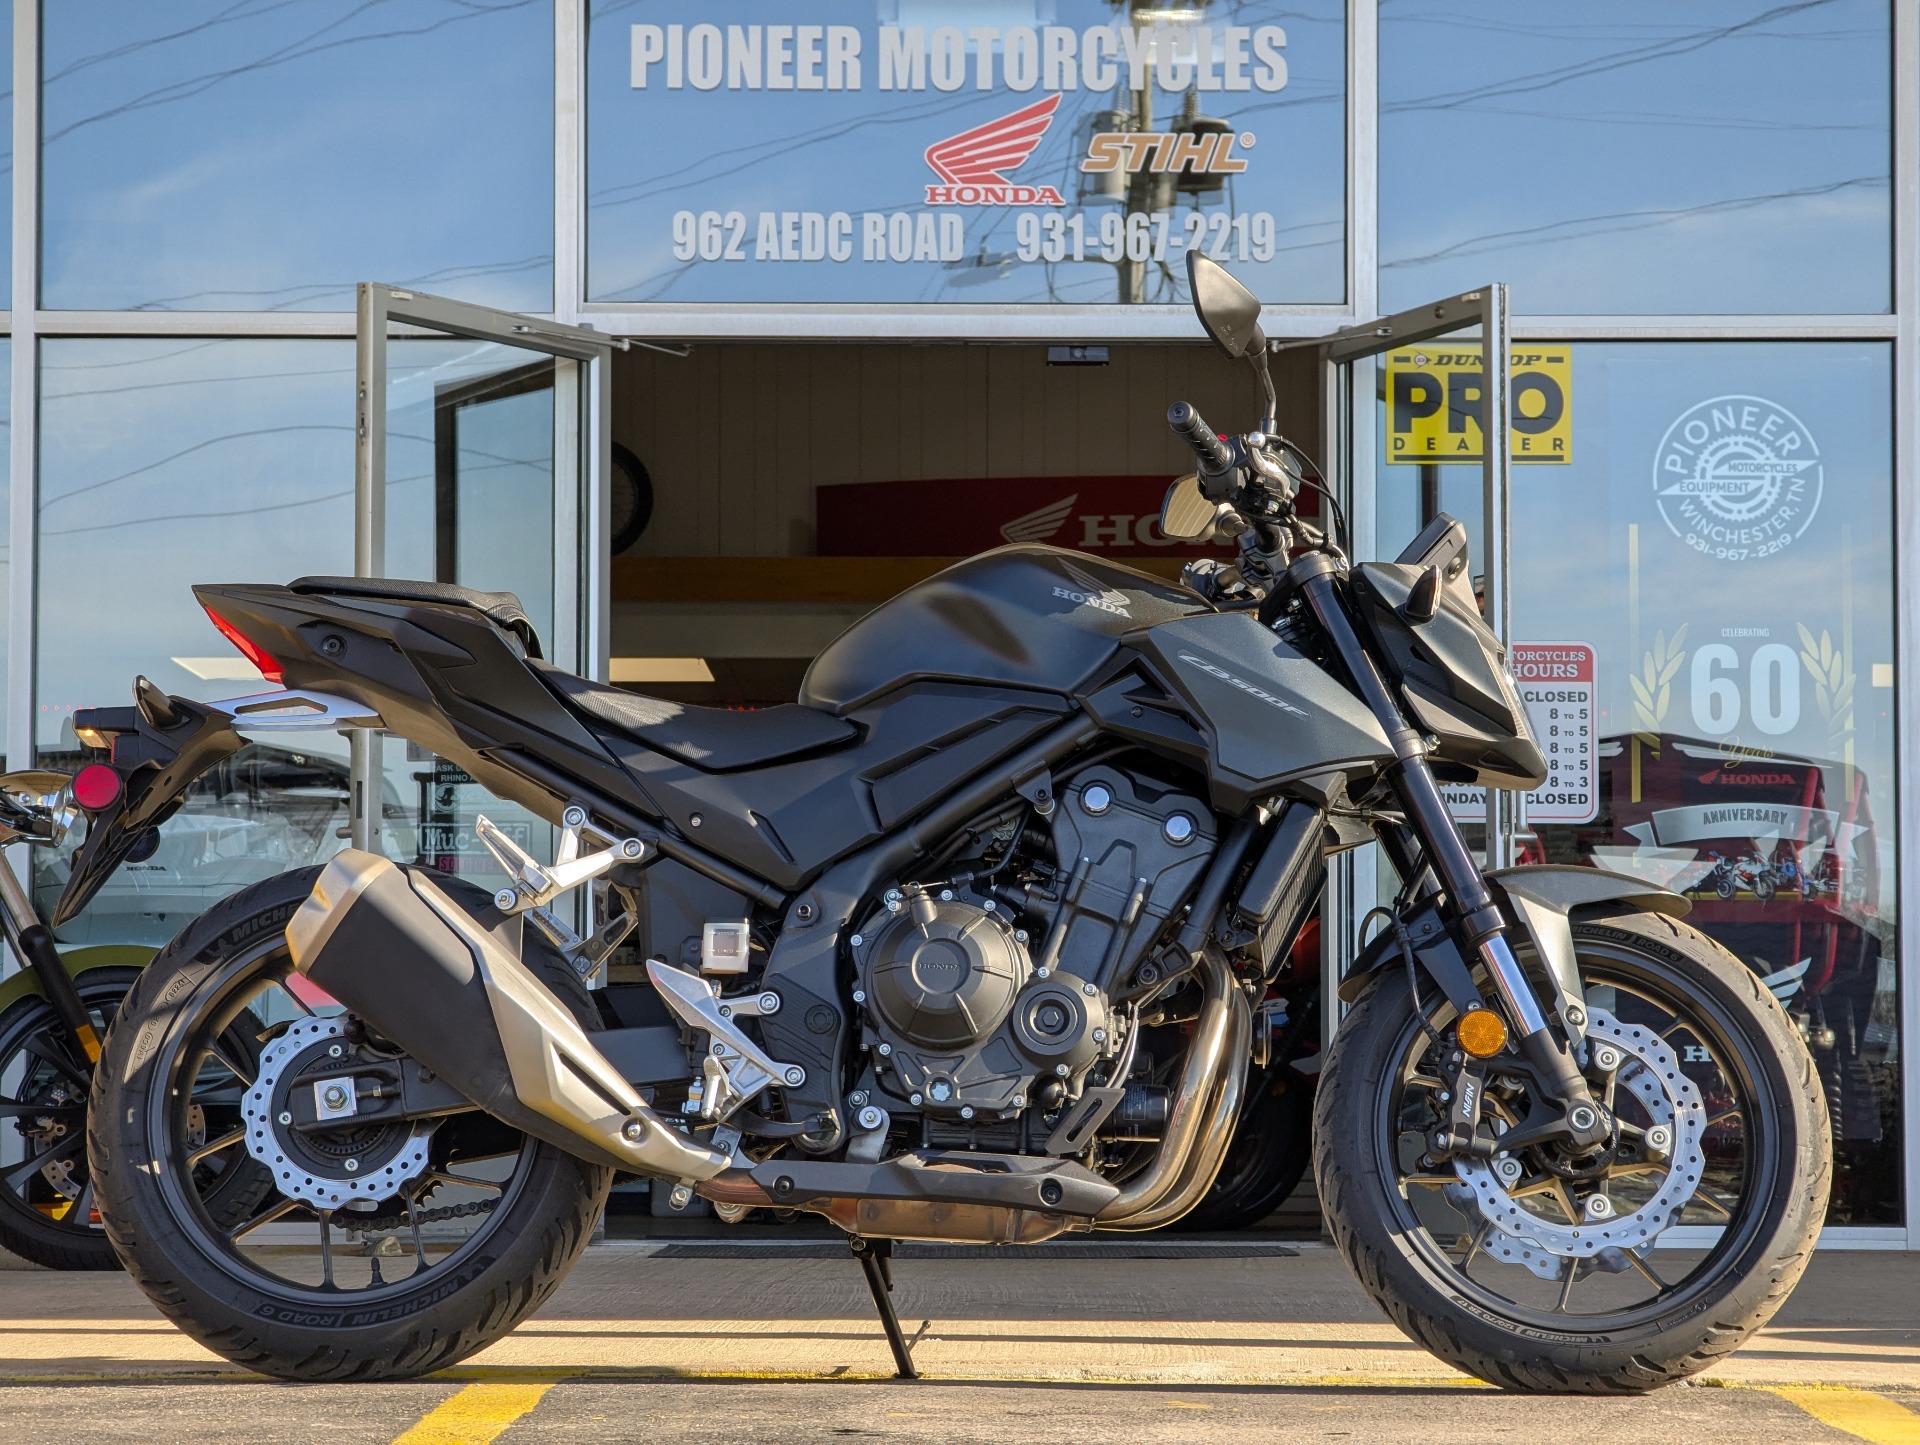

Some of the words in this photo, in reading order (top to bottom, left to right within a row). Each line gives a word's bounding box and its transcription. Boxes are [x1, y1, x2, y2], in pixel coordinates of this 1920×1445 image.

[629, 23, 863, 92] PIONEER
[878, 25, 1290, 93] MOTORCYCLES
[1081, 132, 1249, 173] STIHL
[924, 184, 1065, 206] HONDA
[672, 210, 747, 262] 962
[754, 211, 853, 262] AEDC
[871, 212, 965, 263] ROAD
[1016, 211, 1276, 263] 931-967-2219
[1434, 354, 1542, 366] DUNOP
[1393, 371, 1564, 435] PRO
[1393, 437, 1565, 451] DEAER
[1664, 405, 1801, 475] PIONEER
[1728, 462, 1798, 474] MOTORCYCLES
[1679, 481, 1750, 494] EQUIPMENT
[1679, 498, 1801, 544] WINCHESTER,
[1786, 478, 1806, 503] TN
[1685, 532, 1792, 561] 931-967-2219
[1051, 586, 1132, 620] HONDA
[1721, 628, 1770, 638] CELEBRATING
[1512, 664, 1579, 679] HOURS
[1690, 643, 1801, 736] 60
[1524, 691, 1589, 703] CLOSED
[1549, 708, 1559, 720] 8
[1578, 708, 1589, 720] 5
[1549, 725, 1559, 737] 8
[1578, 725, 1589, 737] 5
[1549, 742, 1559, 754] 8
[1578, 742, 1589, 754] 5
[1549, 759, 1559, 771] 8
[1578, 759, 1589, 771] 5
[440, 774, 467, 782] RHINO
[1549, 776, 1559, 788] 8
[1578, 776, 1589, 788] 3
[1720, 773, 1796, 785] HONDA
[1442, 793, 1487, 804] NDAY
[1527, 793, 1589, 805] CLOSED
[1702, 806, 1789, 826] ANNIVERSARY
[1571, 925, 1628, 940] MICHELIN
[1638, 938, 1669, 954] ROAD
[1670, 953, 1681, 962] 6
[918, 962, 962, 971] HONDA
[352, 1279, 458, 1326] MICHELIN
[259, 1303, 276, 1317] 6
[277, 1310, 335, 1327] ROAD
[1482, 1312, 1514, 1330] 120/70
[1525, 1329, 1588, 1343] MICHELIN
